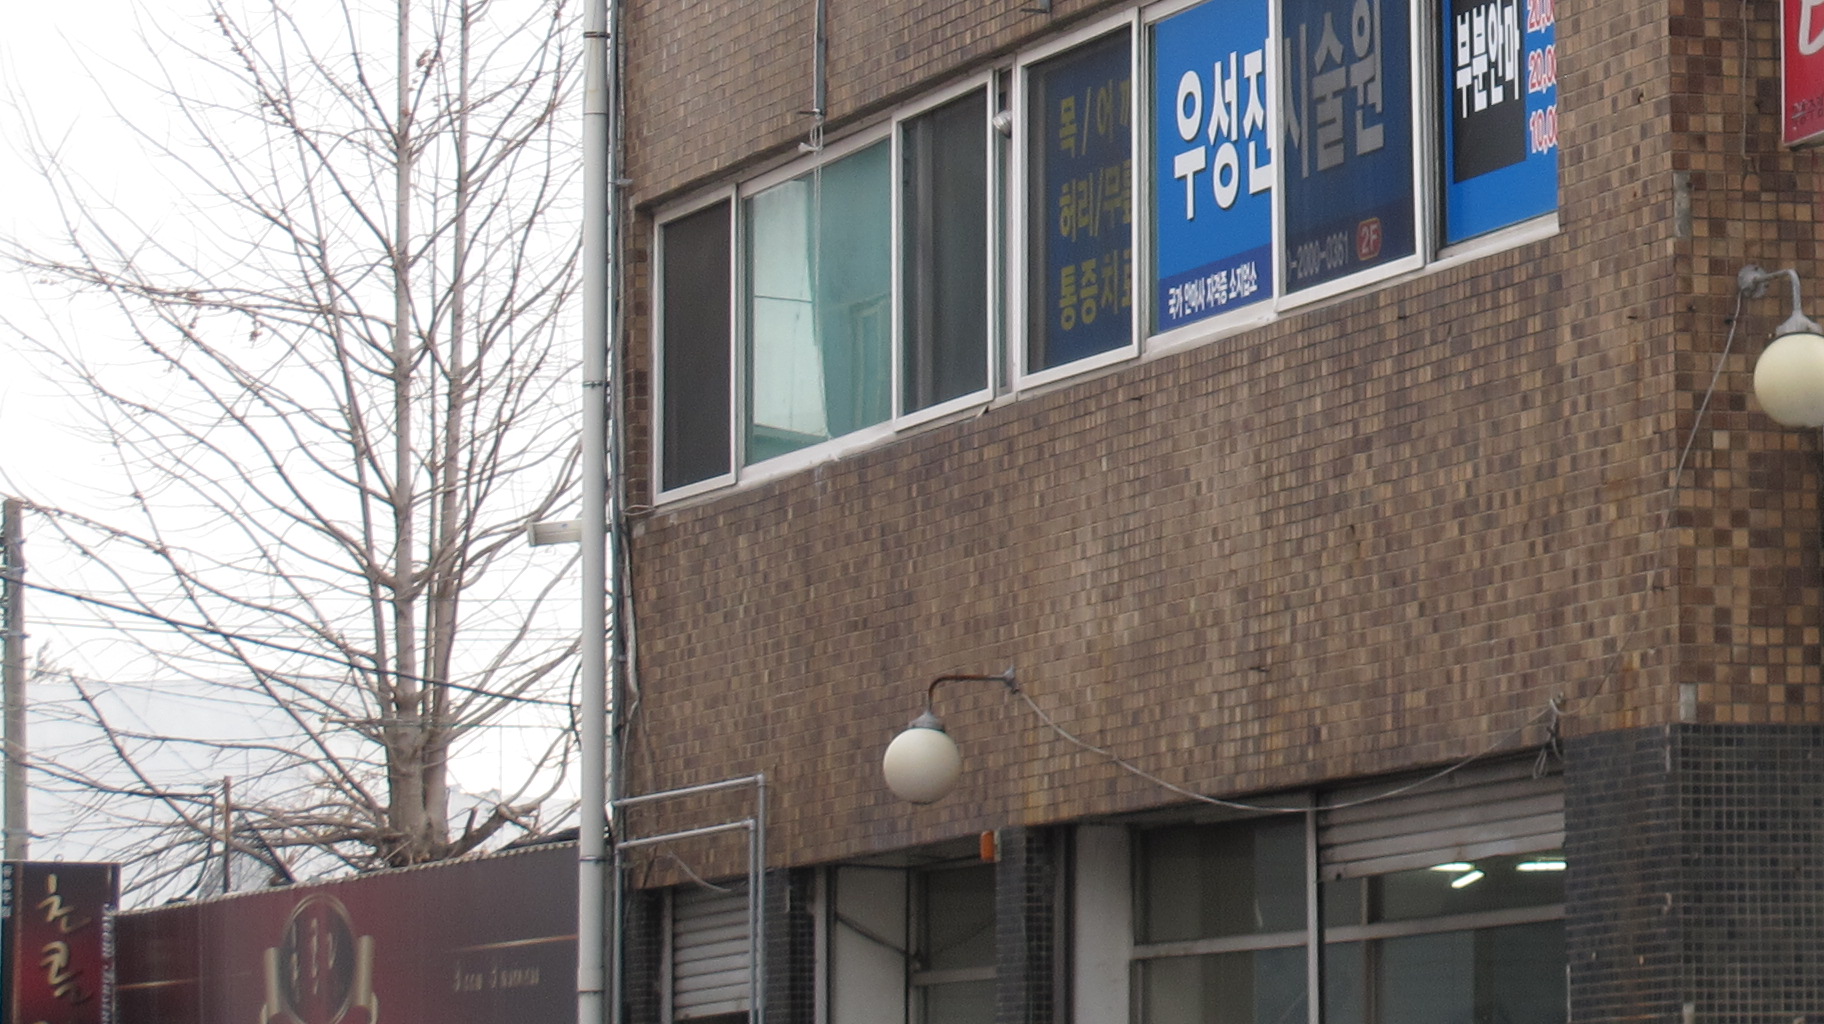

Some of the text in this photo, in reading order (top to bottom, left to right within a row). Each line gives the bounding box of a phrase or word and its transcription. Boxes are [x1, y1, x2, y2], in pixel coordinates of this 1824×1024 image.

[1528, 44, 1557, 94] 20,0
[1530, 104, 1558, 154] 10,0
[1360, 224, 1378, 254] 2F
[1168, 261, 1258, 320] 국가 안마사 자격증 소지업소
